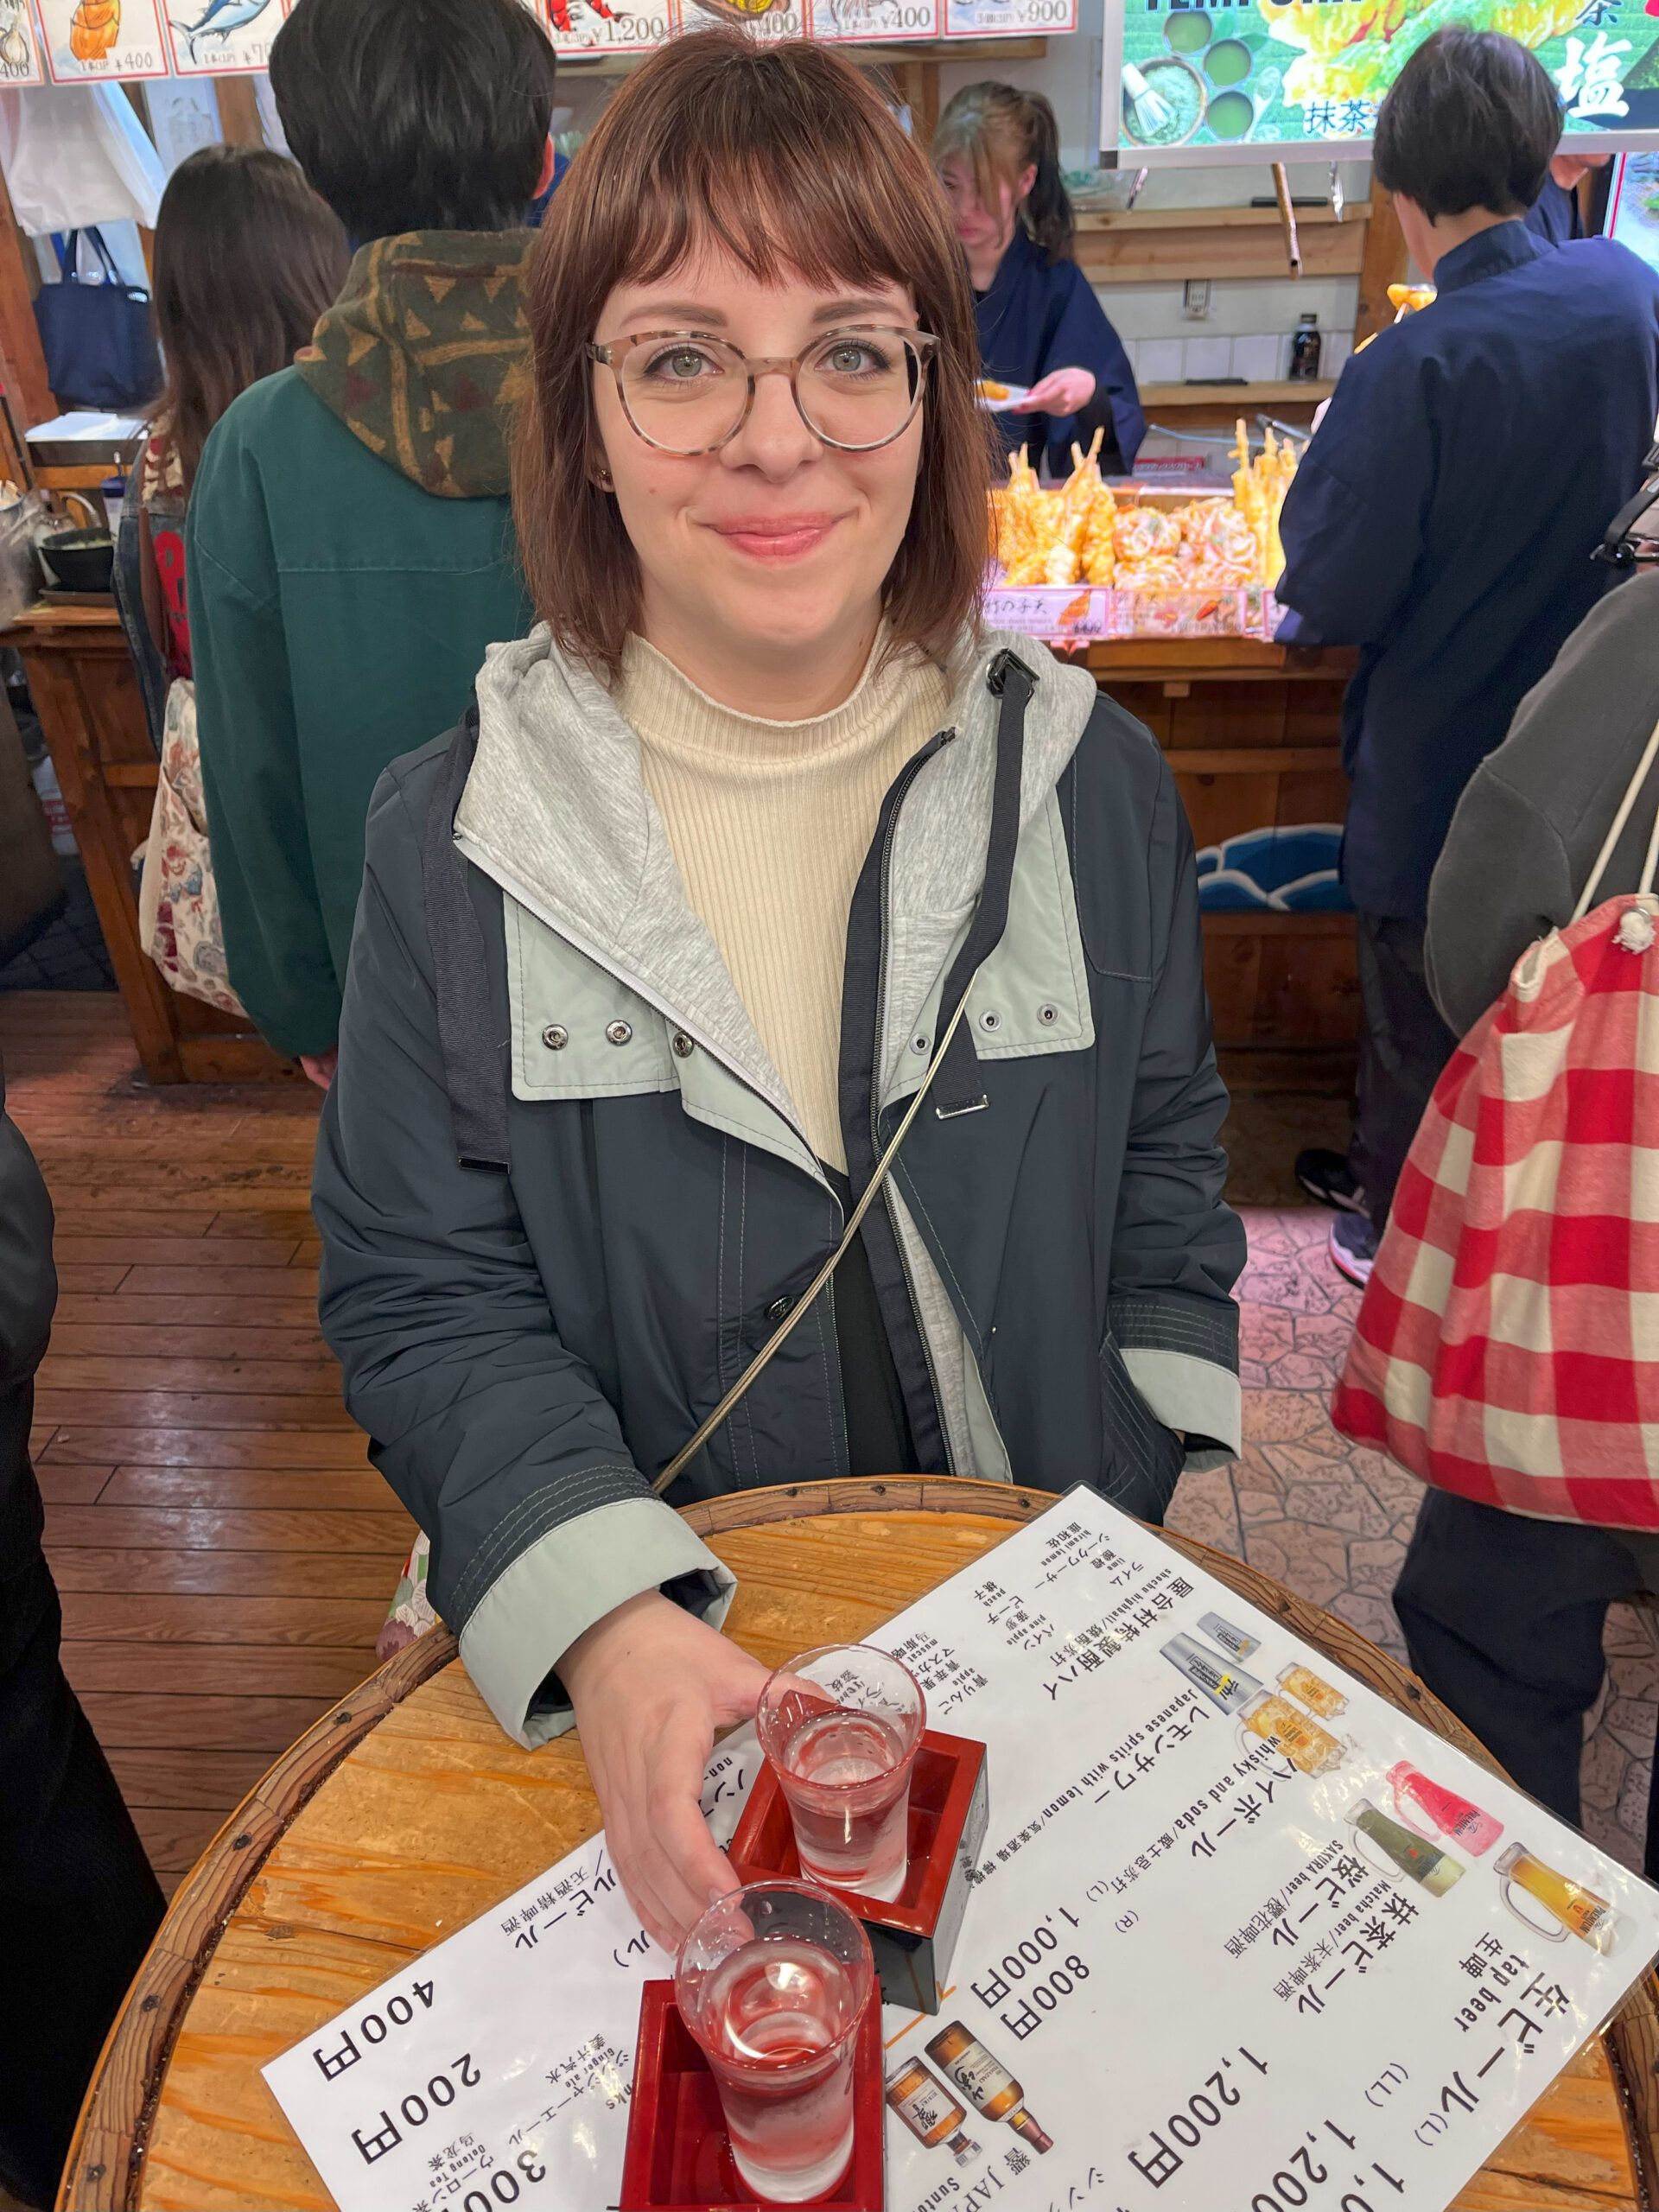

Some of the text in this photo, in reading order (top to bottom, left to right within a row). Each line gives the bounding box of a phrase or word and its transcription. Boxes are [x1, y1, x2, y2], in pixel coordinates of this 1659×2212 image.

[1554, 30, 1633, 118] 塩
[1303, 99, 1378, 135] 抹茶
[1034, 1533, 1110, 1589] シークワーサー
[1040, 1529, 1092, 1567] hirami lemon
[1106, 1557, 1126, 1571] lime
[974, 1580, 998, 1600] 桃子
[1109, 1561, 1144, 1586] ライム
[1141, 1568, 1172, 1593] shochu
[982, 1587, 1007, 1607] peach
[988, 1595, 1024, 1625] ピーチ
[906, 1638, 938, 1663] muscat
[1006, 1614, 1046, 1646] pine apple
[1024, 1624, 1054, 1650] パイン
[1042, 1576, 1194, 1700] 屋台村特製酎ハイ
[919, 1659, 961, 1691] 青苹果
[938, 1674, 988, 1715] 青りんご
[952, 1668, 976, 1686] apple
[1145, 1688, 1198, 1732] Japanese
[1094, 1706, 1210, 1803] レモンサワー
[1109, 1732, 1145, 1763] sprits
[1232, 1736, 1281, 1777] whisky
[1080, 1763, 1109, 1787] with
[1207, 1776, 1235, 1803] and
[1192, 1758, 1298, 1858] ハイボール
[1305, 1840, 1344, 1875] SAKURA
[515, 1868, 617, 1949] ルビール
[1273, 1854, 1370, 1947] 桜ビール
[1354, 1879, 1392, 1913] Matcha
[969, 1880, 1109, 2010] (L) 1,000円
[1298, 1892, 1420, 2014] 抹茶ビール
[1458, 1932, 1503, 1979] 生啤
[1000, 1910, 1139, 2041] (R) 800円
[1453, 1955, 1529, 2033] tap beer
[313, 1980, 434, 2082] 400円
[1440, 1972, 1570, 2113] 生ビール
[565, 2047, 615, 2088] Ginger ale
[1364, 2063, 1409, 2107] (LL)
[351, 2052, 481, 2165] 200円
[605, 2079, 632, 2110] nks
[1128, 2046, 1268, 2190] 1,200円
[1414, 2113, 1448, 2146] (L)
[429, 2144, 486, 2188] Oolong Tea
[441, 2149, 547, 2212] 300
[912, 2177, 961, 2212] Sunto
